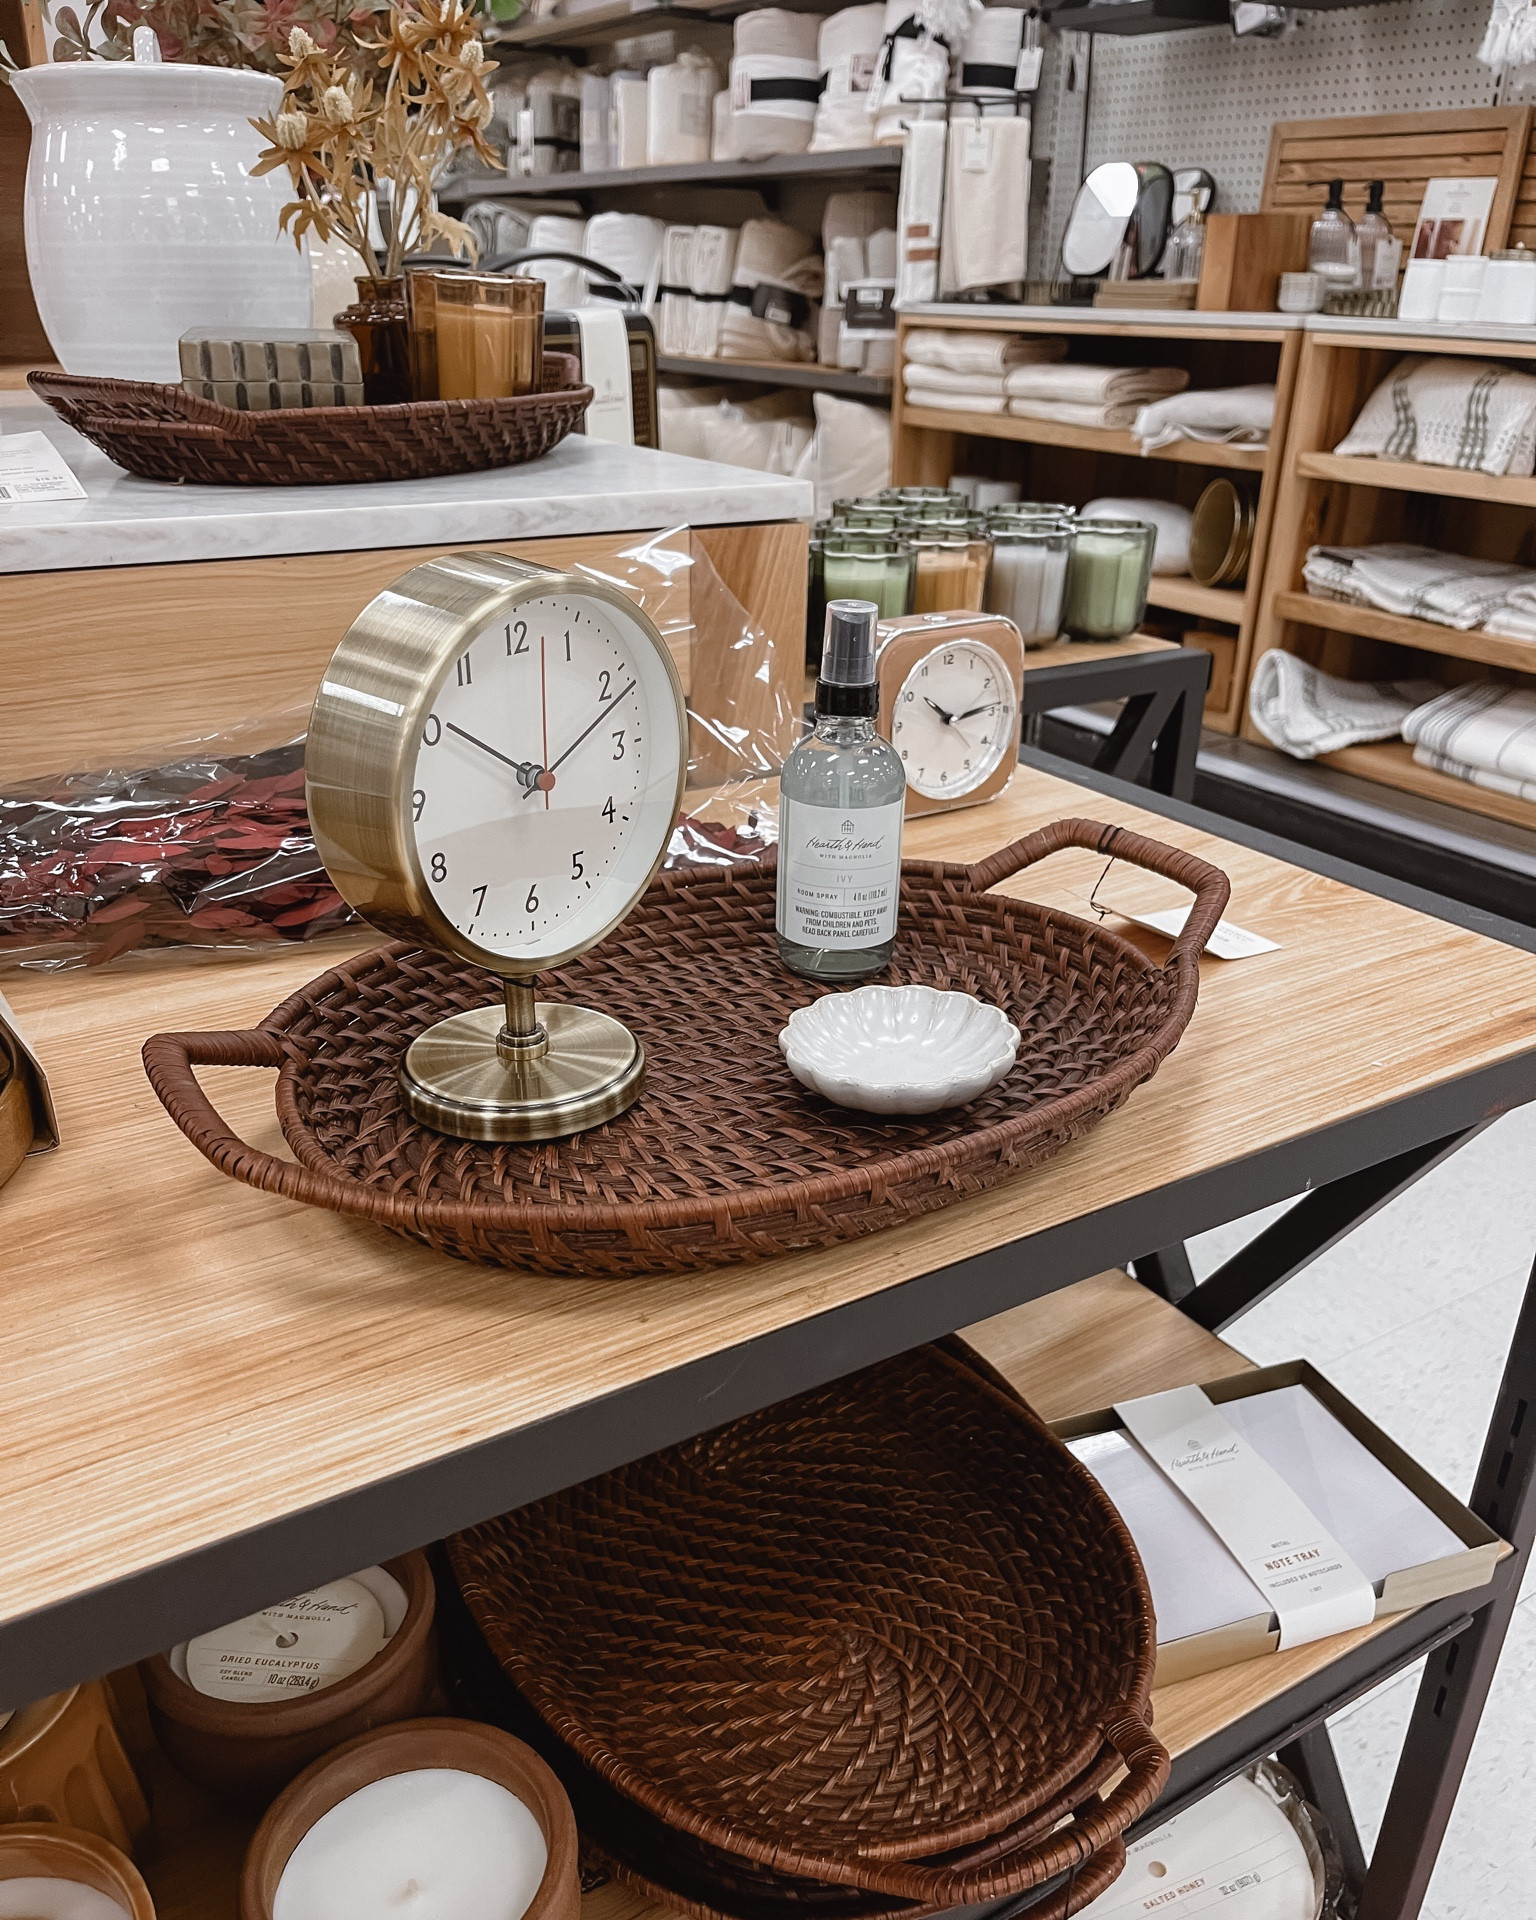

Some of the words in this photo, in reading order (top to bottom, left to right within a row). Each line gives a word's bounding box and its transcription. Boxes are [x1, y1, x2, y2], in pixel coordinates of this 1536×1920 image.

[504, 620, 530, 656] 12
[564, 630, 571, 662] 1
[943, 654, 954, 665] 12
[969, 660, 974, 670] 1
[457, 651, 472, 687] 11
[921, 666, 929, 676] 11
[598, 670, 612, 702] 2
[984, 678, 991, 689] 2
[902, 691, 914, 702] 10
[422, 713, 442, 747] 0
[612, 730, 626, 761] 3
[980, 736, 988, 745] 4
[901, 750, 908, 760] 8
[963, 760, 970, 770] 5
[918, 767, 925, 778] 7
[940, 772, 947, 782] 6
[412, 789, 426, 823] 9
[601, 796, 617, 824] 4
[806, 836, 848, 851] Hearth
[845, 839, 853, 851] &
[852, 835, 885, 851] Hand
[431, 852, 448, 883] 8
[571, 850, 584, 880] 5
[836, 875, 853, 883] IVY
[525, 883, 539, 914] 6
[797, 888, 814, 897] ROOM
[472, 884, 488, 917] 7
[795, 905, 819, 917] WARNING:
[863, 909, 876, 918] KEEP
[805, 918, 822, 926] FROM
[822, 919, 851, 928] CHILDREN
[852, 919, 864, 928] AND
[802, 926, 816, 935] READ
[817, 928, 832, 937] BACK
[832, 930, 851, 938] PANEL
[1264, 1556, 1294, 1571] NOTE
[1293, 1548, 1321, 1562] TRAY
[299, 1598, 311, 1610] &
[308, 1599, 359, 1615] Hand
[285, 1613, 331, 1622] MAGNOLIA
[220, 1655, 252, 1665] DRIED
[254, 1658, 320, 1670] EUCALYPTUS
[267, 1674, 278, 1685] 10
[1144, 1891, 1176, 1909] SALTED
[1176, 1877, 1206, 1896] HONEY
